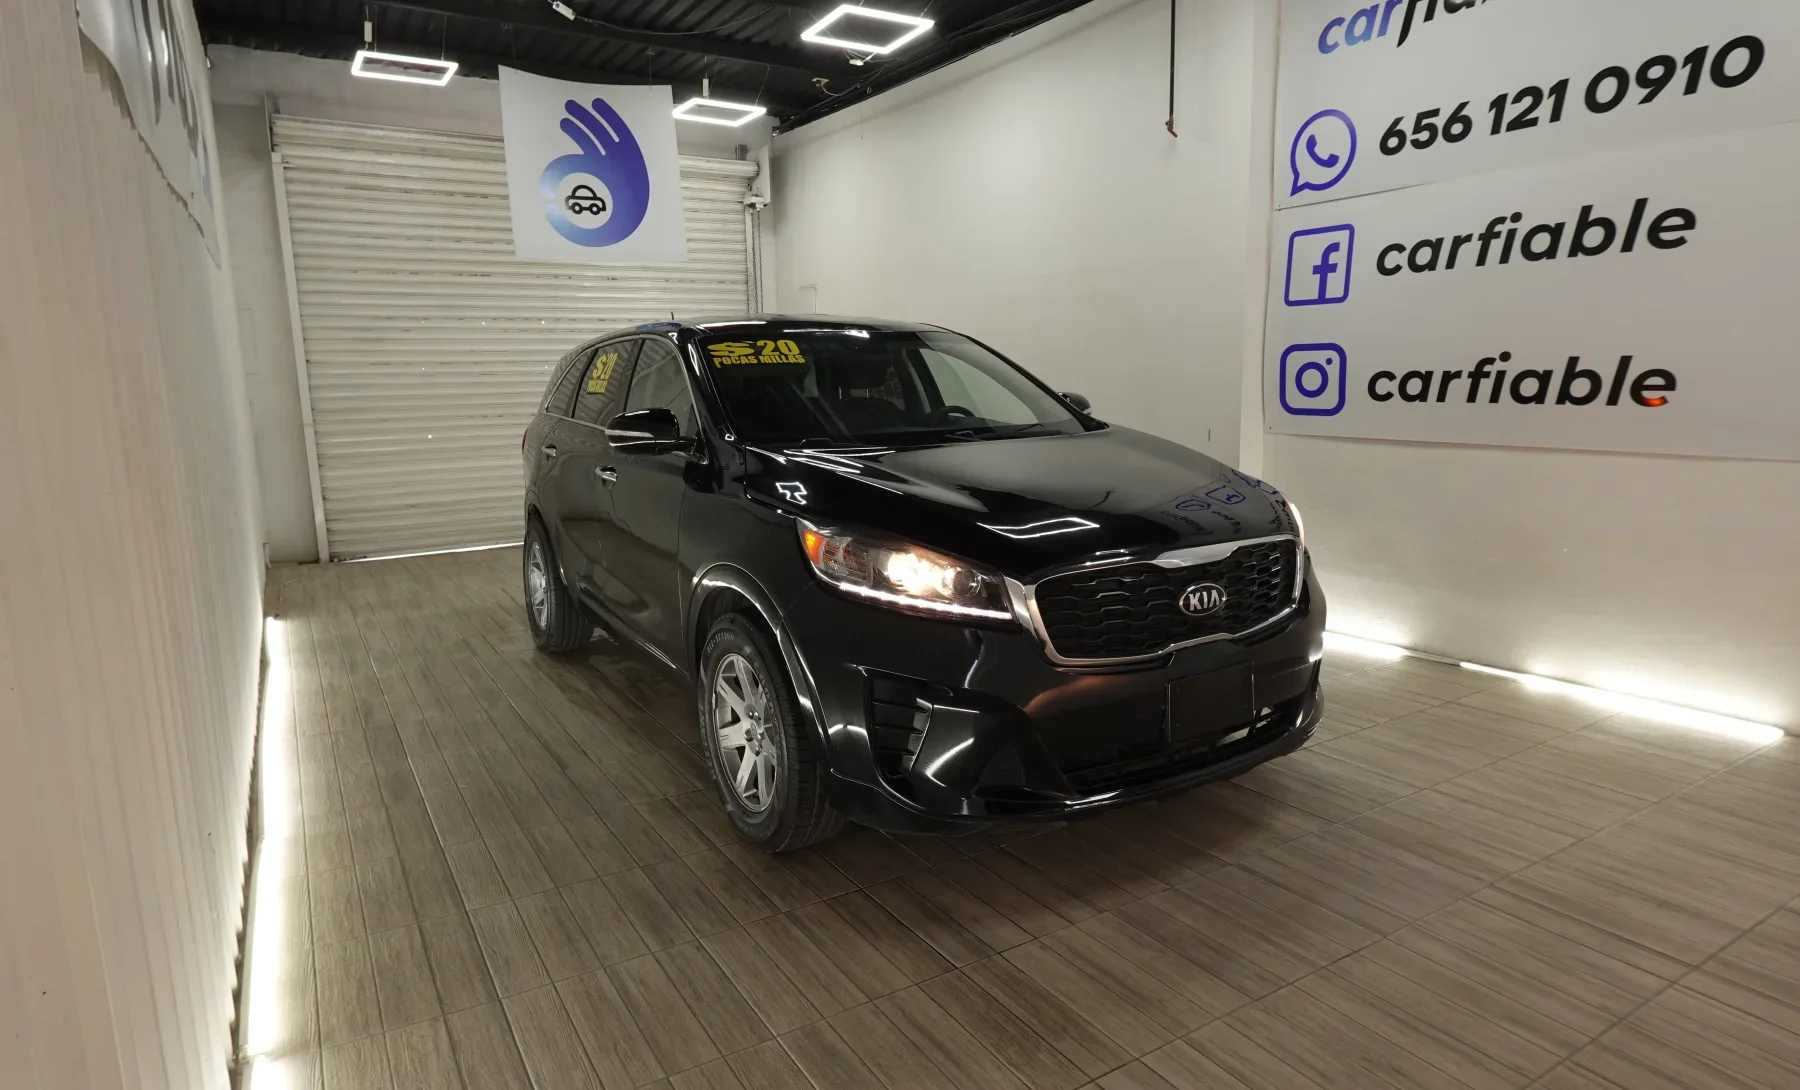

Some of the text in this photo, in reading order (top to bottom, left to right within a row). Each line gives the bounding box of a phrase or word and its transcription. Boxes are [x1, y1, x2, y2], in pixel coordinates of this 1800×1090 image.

[1379, 35, 1765, 156] 656 121 0910
[1376, 198, 1697, 276] carfiable
[713, 355, 805, 368] POCAS MILLAS
[1367, 351, 1677, 407] carfiable
[1188, 589, 1220, 611] KIA
